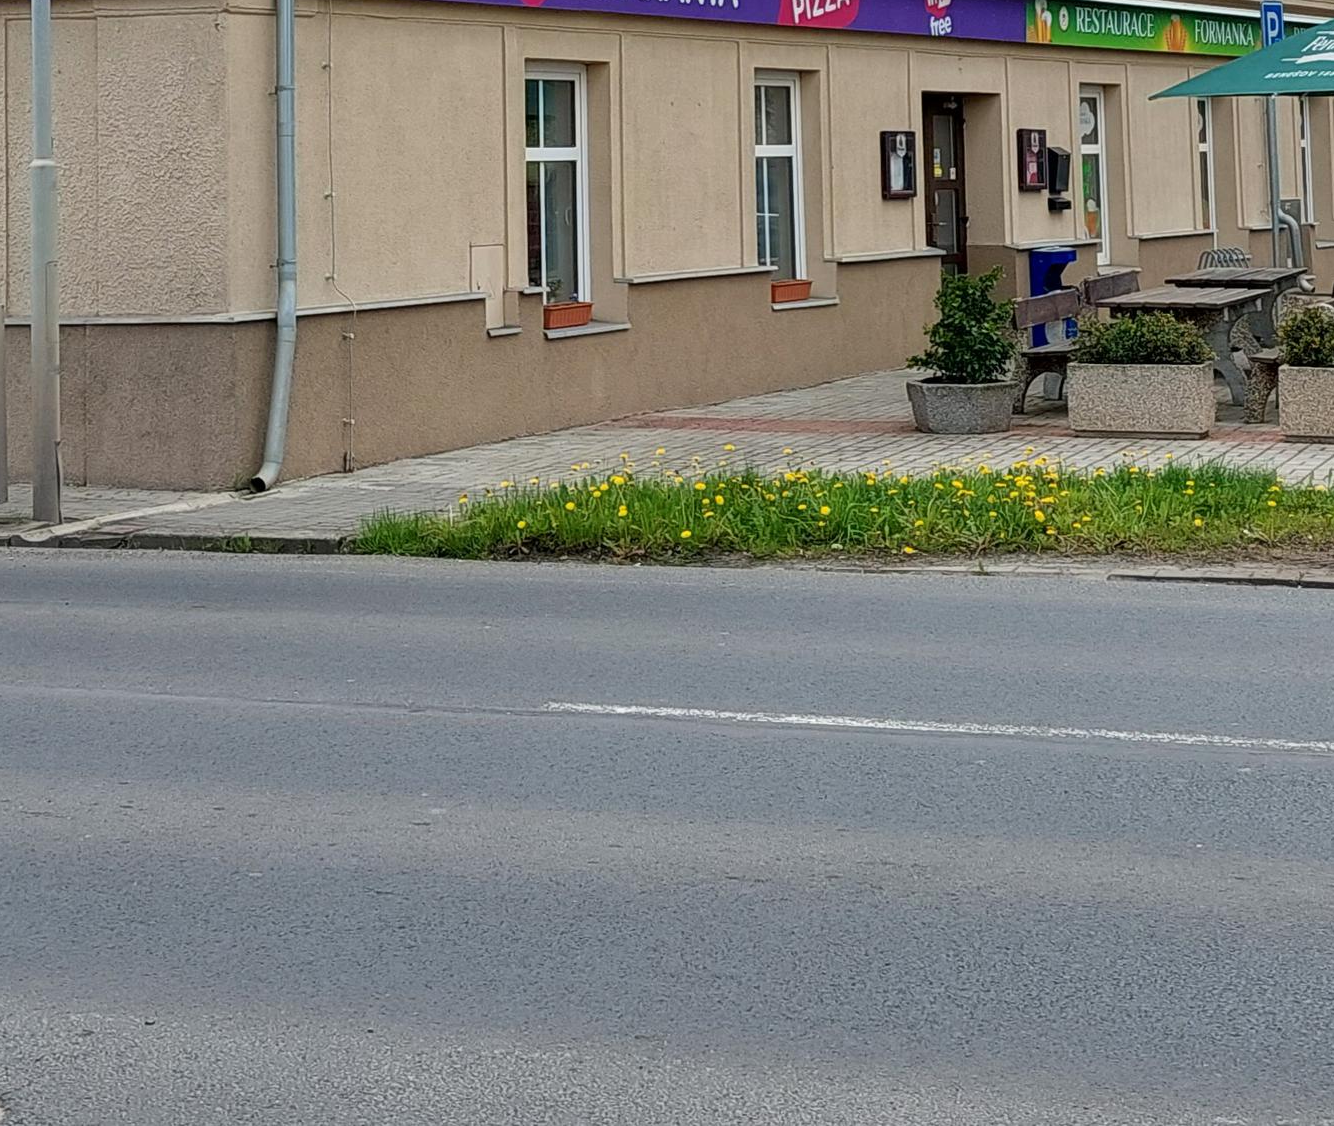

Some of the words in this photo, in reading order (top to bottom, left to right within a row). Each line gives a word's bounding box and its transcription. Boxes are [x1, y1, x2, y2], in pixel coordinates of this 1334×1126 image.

[930, 16, 952, 37] free
[1075, 6, 1155, 38] RESTAURACE
[1194, 19, 1255, 47] FORMANKA
